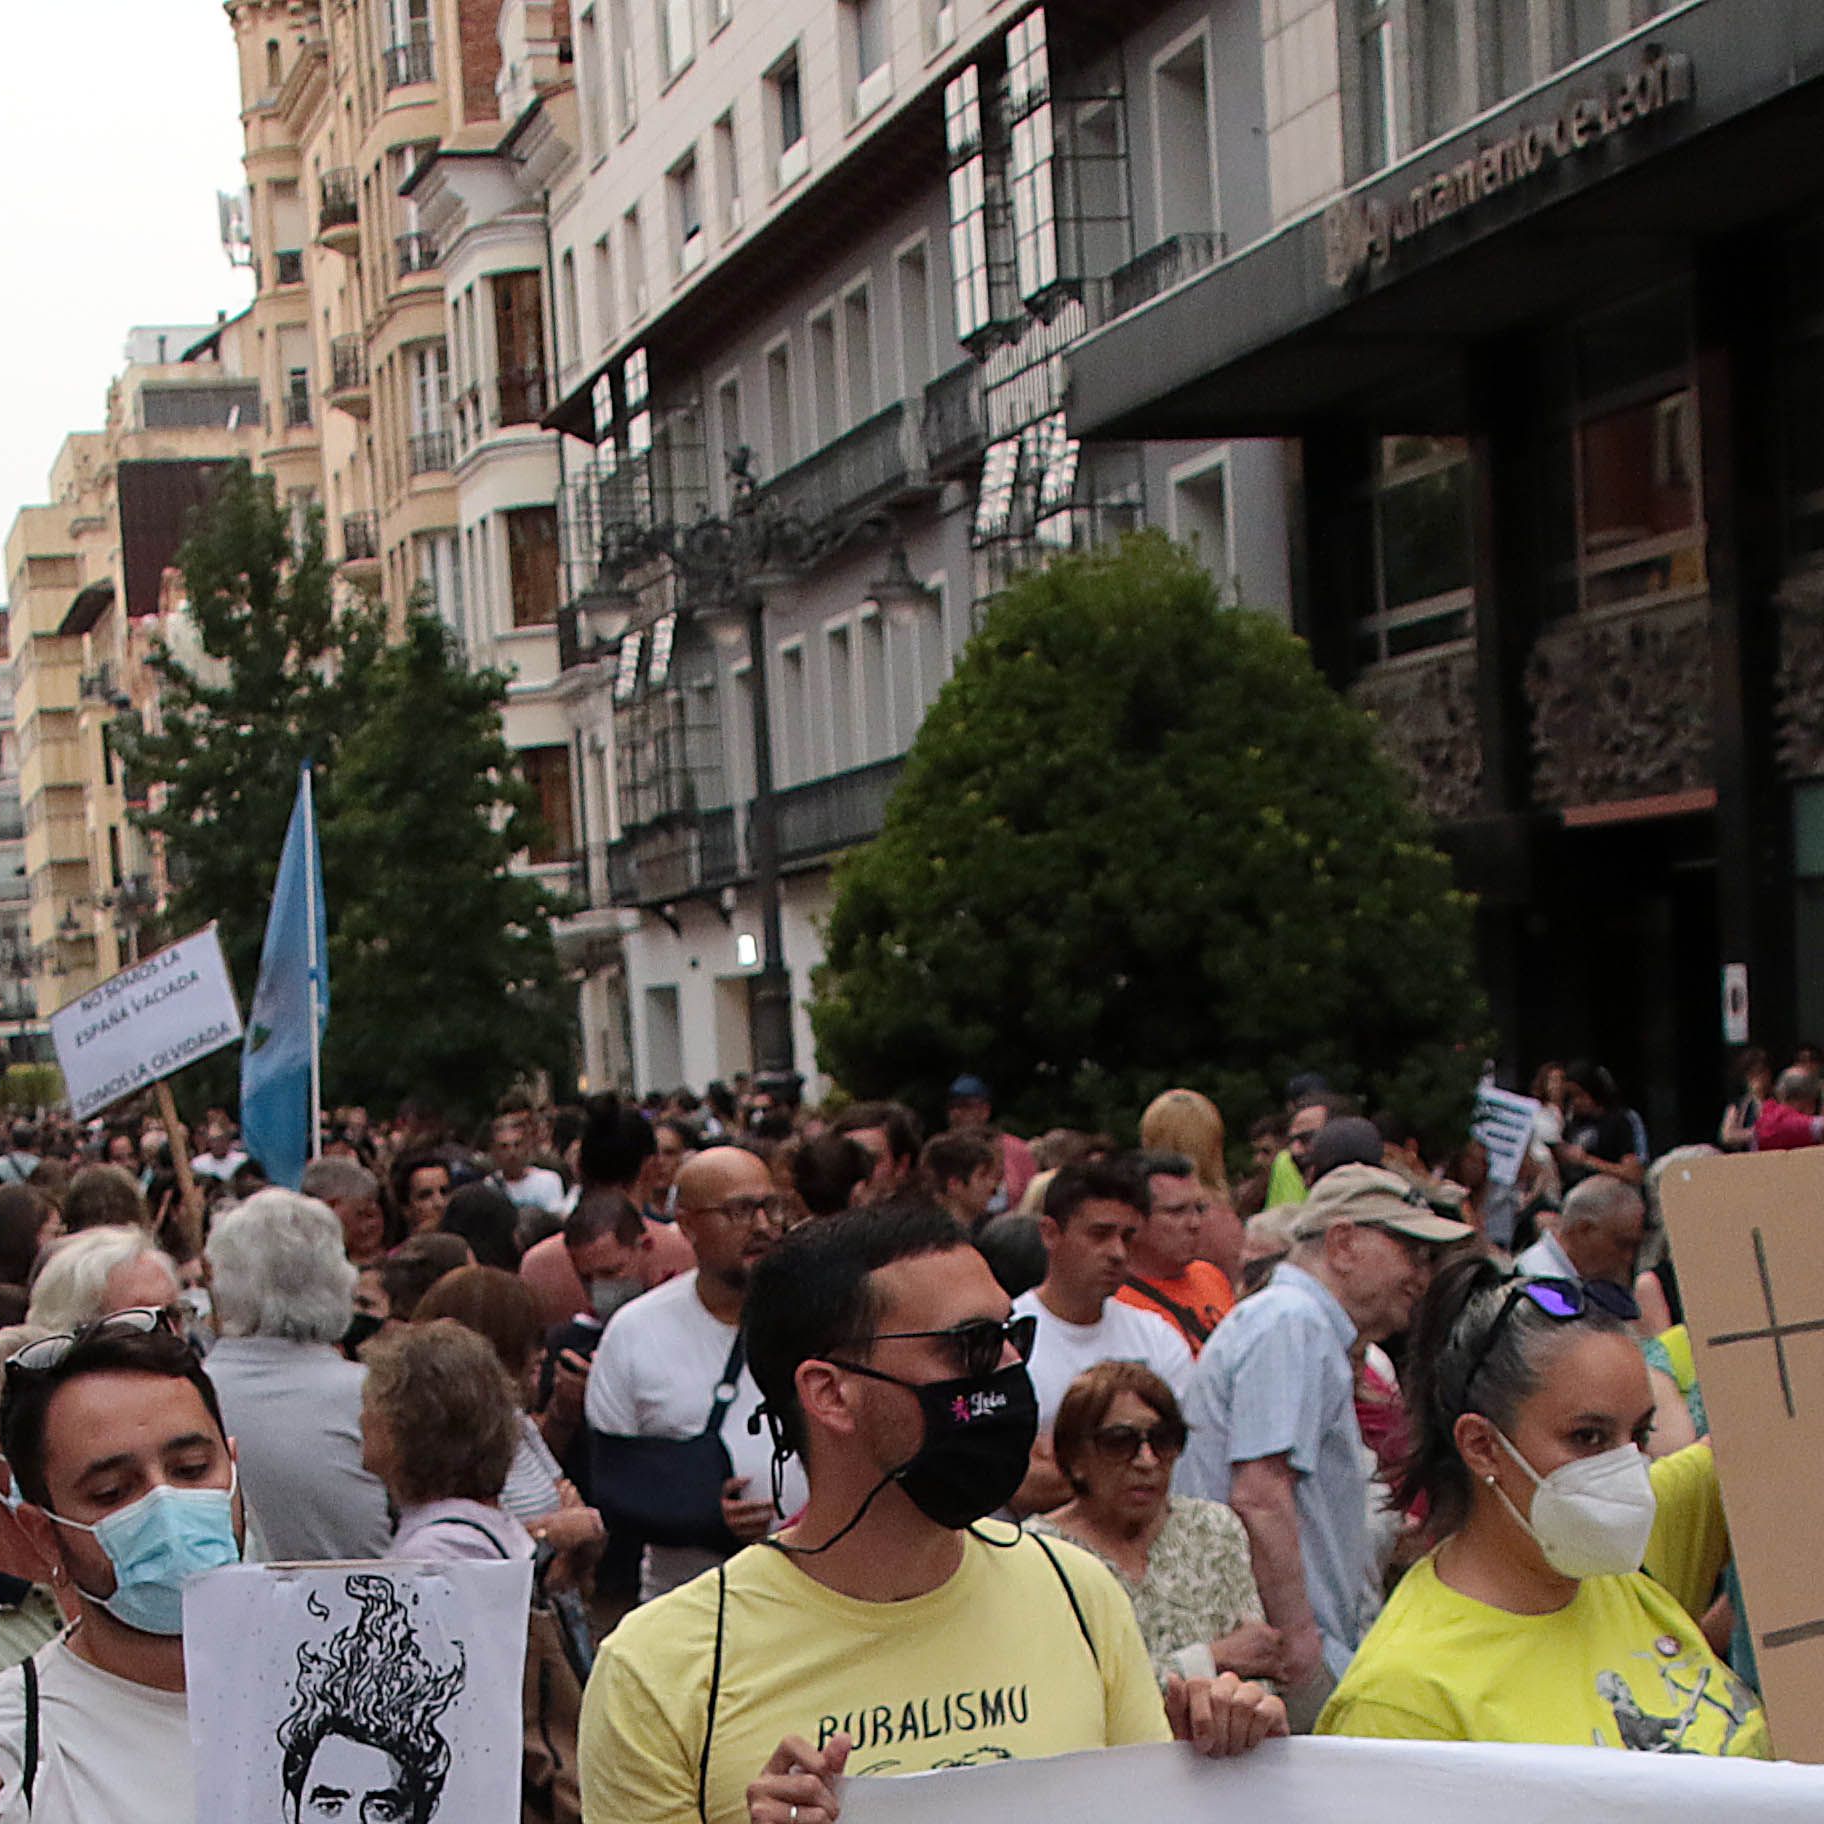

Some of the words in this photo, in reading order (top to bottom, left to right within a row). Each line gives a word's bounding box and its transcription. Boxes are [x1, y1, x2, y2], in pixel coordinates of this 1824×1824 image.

[81, 991, 103, 1012] NO
[104, 961, 161, 999] SOMOS
[160, 948, 181, 968] LA
[131, 968, 200, 1014] VACIADA
[131, 1062, 148, 1082] LA
[150, 1020, 231, 1070] OLVIDADA
